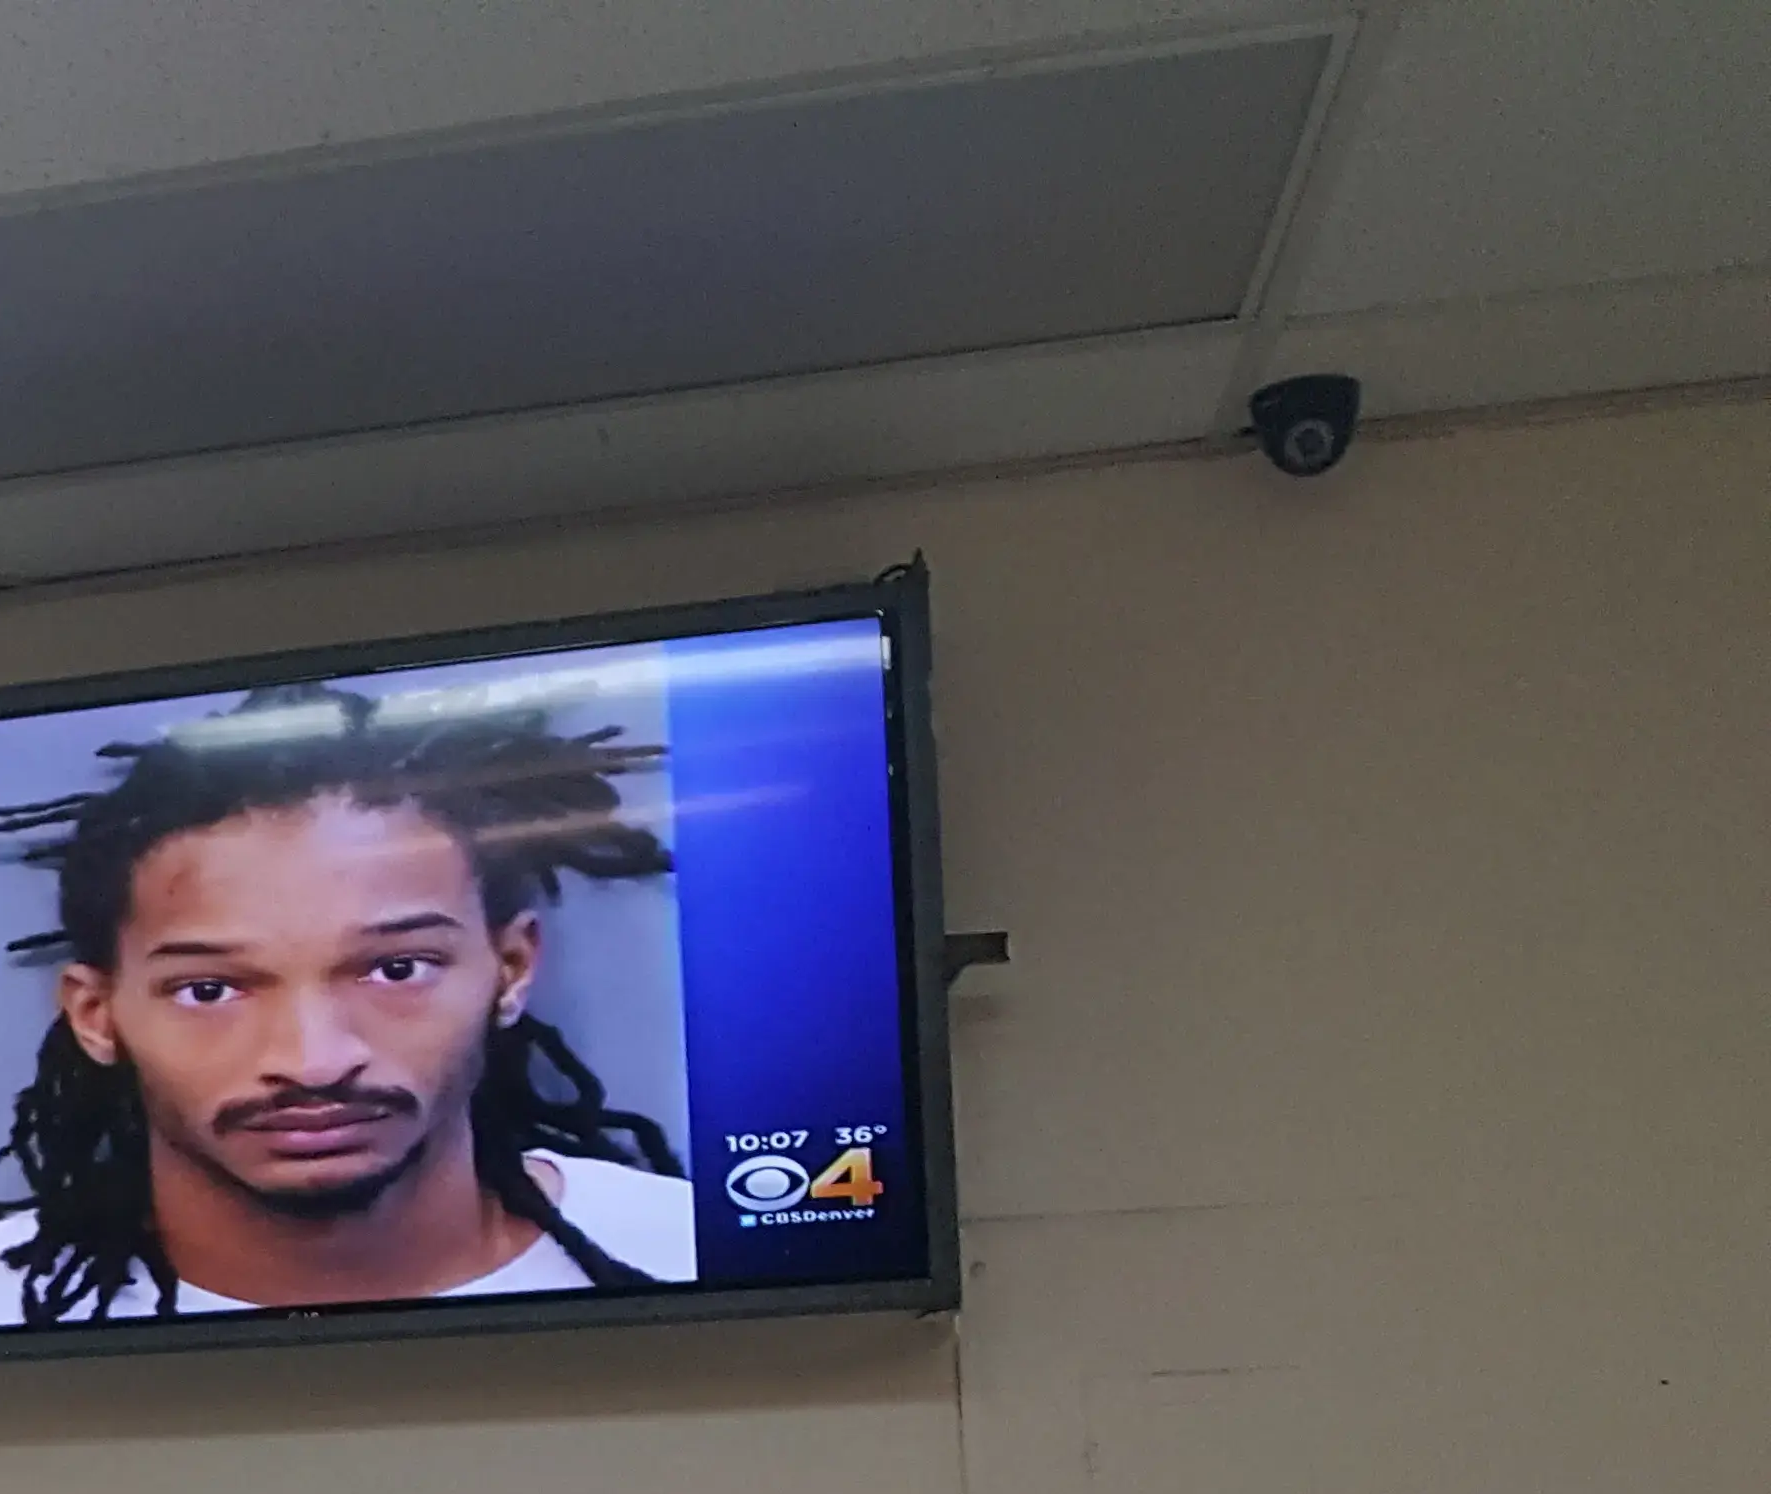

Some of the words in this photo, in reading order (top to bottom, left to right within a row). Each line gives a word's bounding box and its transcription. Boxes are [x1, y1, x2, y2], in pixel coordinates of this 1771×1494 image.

[725, 1130, 809, 1152] 10:07
[835, 1124, 888, 1145] 36°
[811, 1147, 883, 1206] 4
[760, 1208, 875, 1225] CBSDenver
